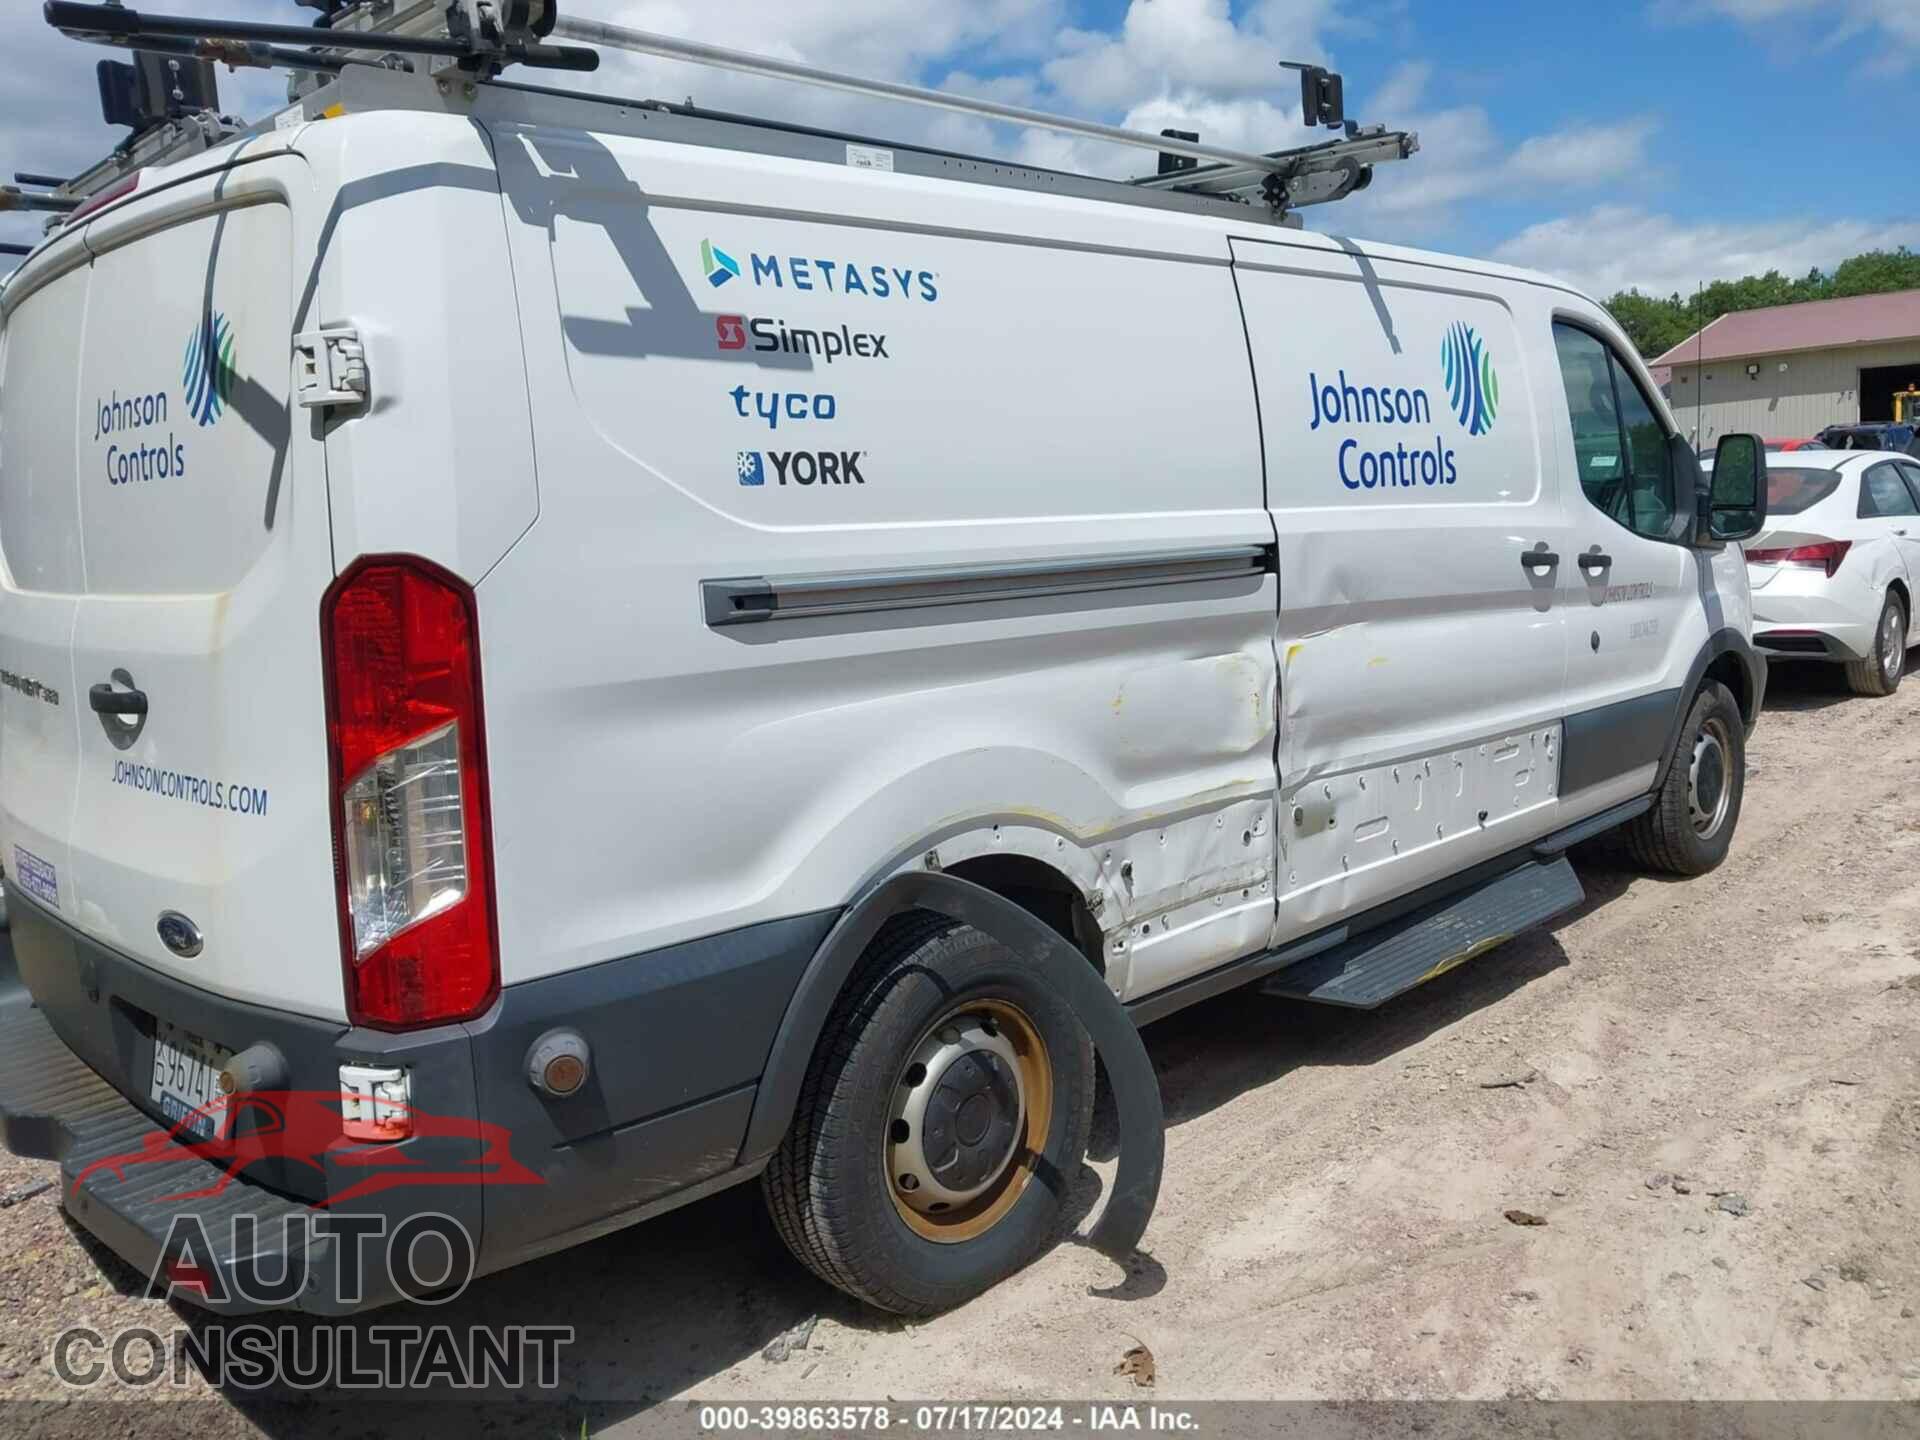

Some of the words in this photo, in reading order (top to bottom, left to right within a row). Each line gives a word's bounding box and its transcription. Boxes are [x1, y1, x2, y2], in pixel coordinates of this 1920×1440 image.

[750, 253, 938, 302] METASYS
[750, 317, 890, 363] Simplex
[94, 389, 167, 441] Johnson
[728, 384, 836, 430] tyco
[1309, 369, 1431, 431] Johnson
[106, 431, 185, 485] Controls
[766, 450, 866, 486] YORK
[1338, 435, 1457, 490] Controls
[111, 759, 268, 817] JOHNSONCONTROLS.COM
